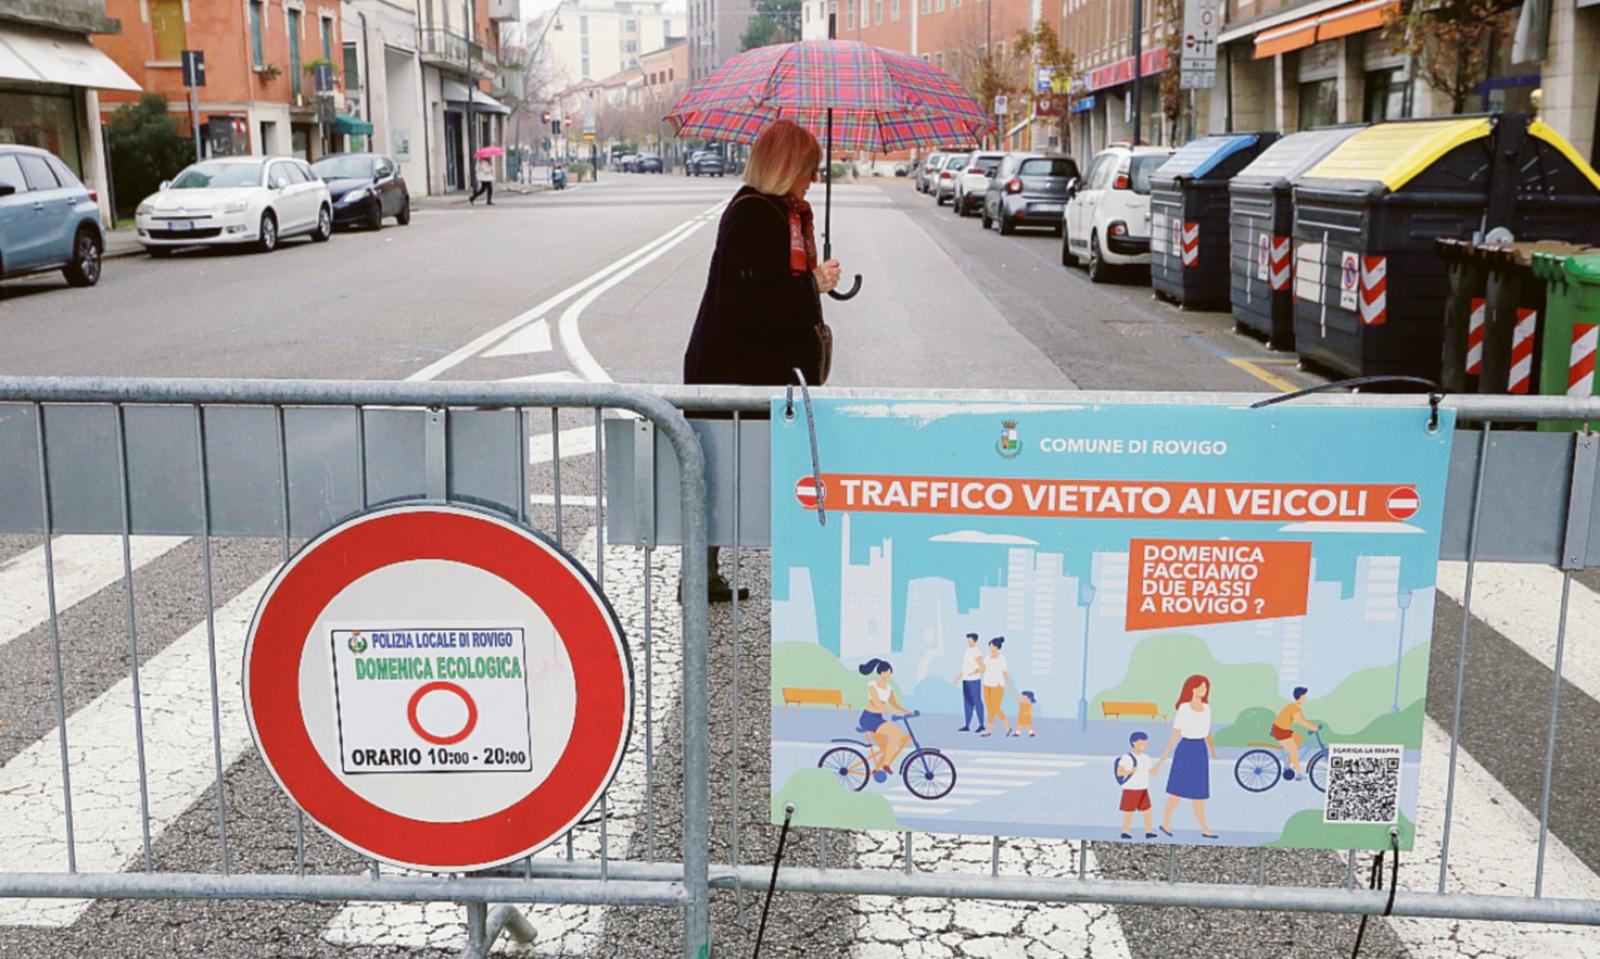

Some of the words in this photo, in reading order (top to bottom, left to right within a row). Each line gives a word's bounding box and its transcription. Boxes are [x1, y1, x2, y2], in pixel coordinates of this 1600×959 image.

[1039, 437, 1123, 454] COMUNE
[1128, 439, 1148, 454] DI
[1152, 440, 1228, 456] ROVIGO
[840, 479, 1014, 511] TRAFFICO
[1021, 484, 1172, 514] VIETATO
[1178, 487, 1216, 515] AI
[1225, 488, 1368, 517] VEICOLI
[1143, 545, 1265, 563] DOMENICA
[1143, 562, 1258, 579] FACCIAMO
[1142, 580, 1186, 596] DUE
[1192, 580, 1251, 597] PASSI
[1140, 597, 1156, 612] A
[1161, 597, 1248, 614] ROVIGO
[1255, 598, 1265, 614] ?
[372, 632, 414, 649] POLIZIA
[416, 633, 457, 648] LOCALE
[459, 633, 471, 648] DI
[473, 632, 513, 648] ROVIGO
[355, 656, 433, 680] DOMENICA
[436, 656, 522, 680] ECOLOGICA
[352, 748, 422, 766] ORARIO
[428, 748, 469, 765] 10:00
[483, 747, 526, 765] 20:00
